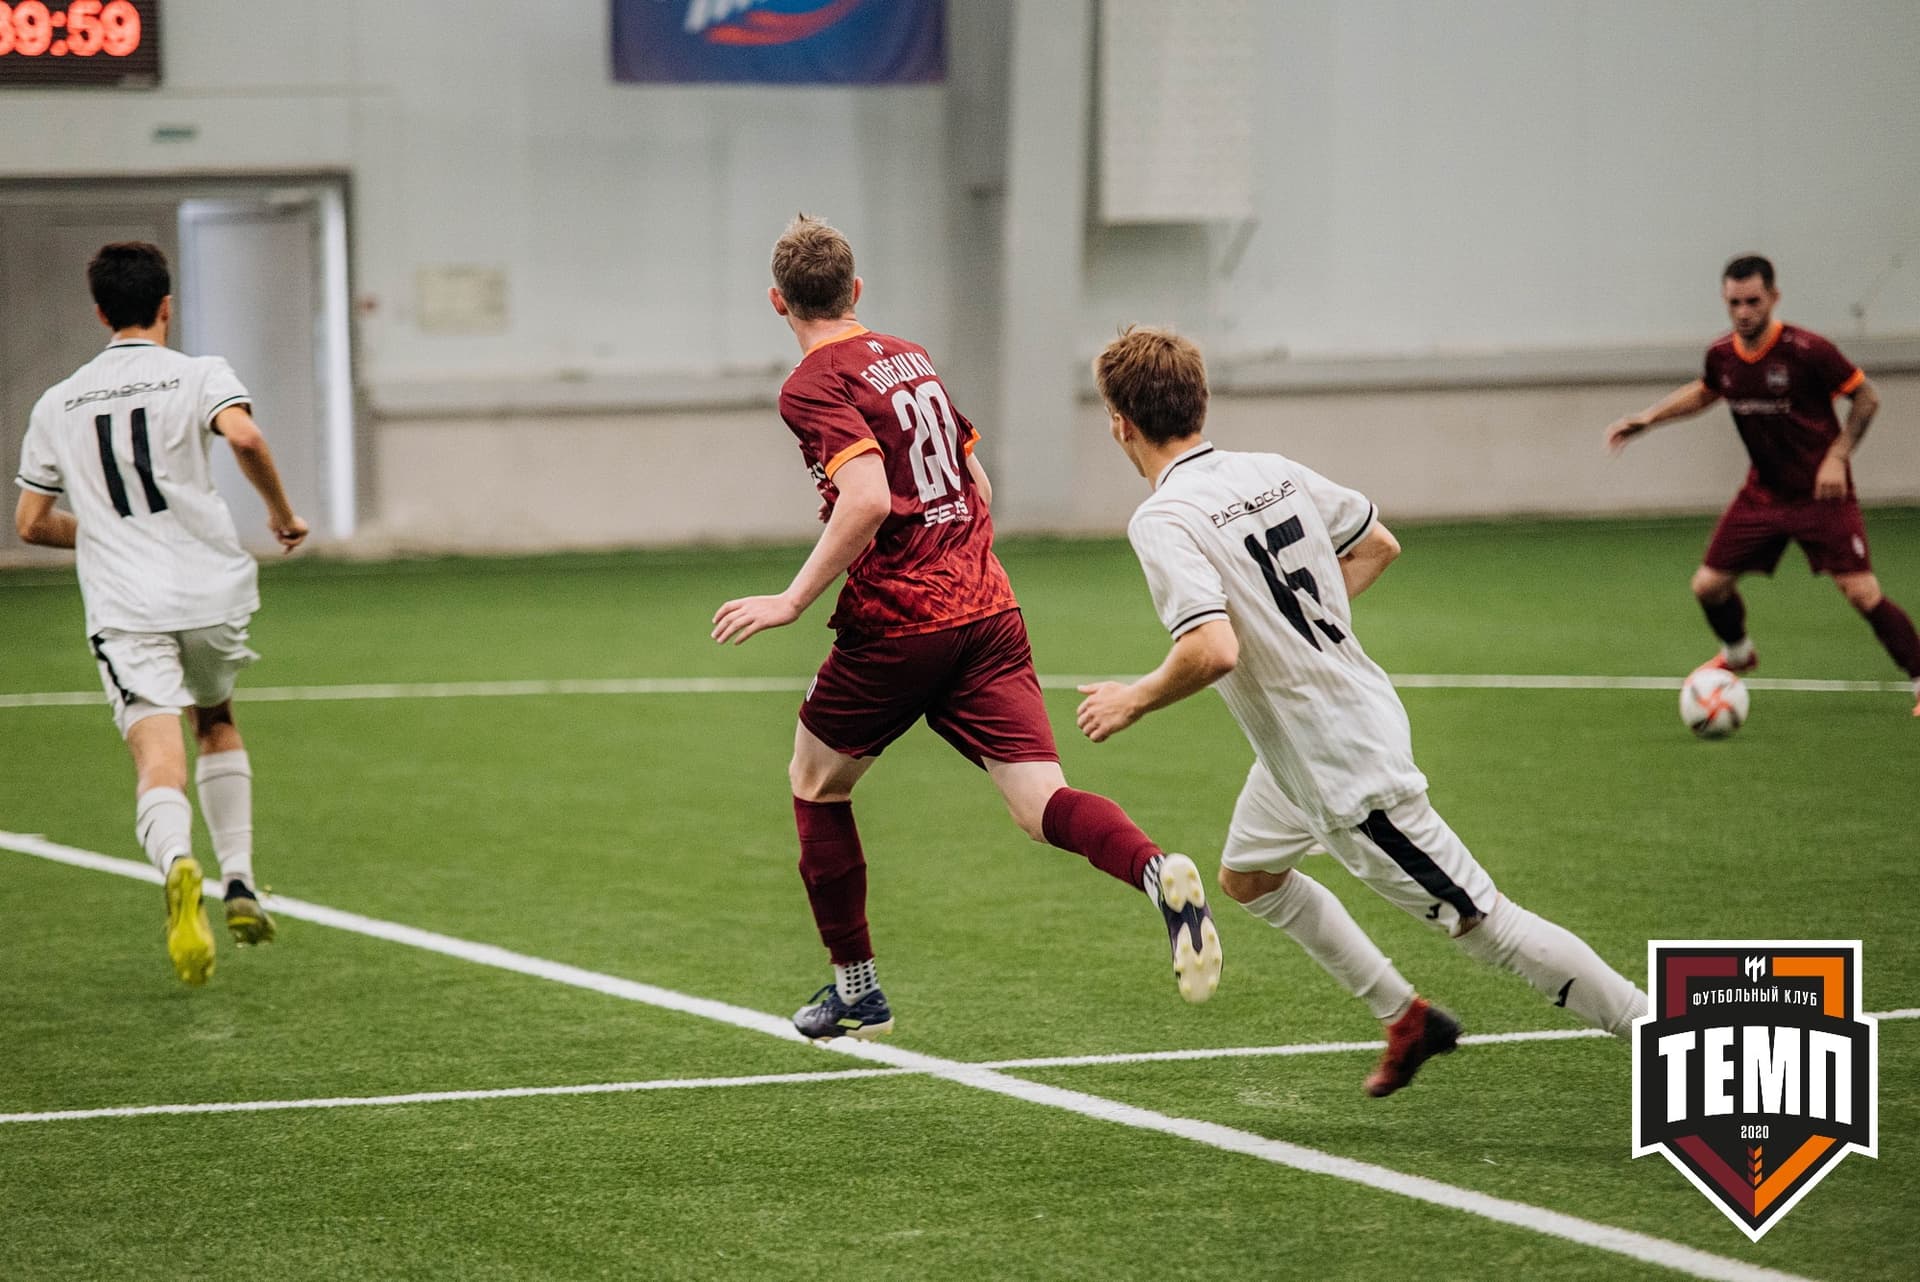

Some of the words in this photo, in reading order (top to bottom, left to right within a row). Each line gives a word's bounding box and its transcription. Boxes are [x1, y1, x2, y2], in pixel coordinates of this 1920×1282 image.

[95, 407, 168, 518] 11
[891, 380, 961, 504] 20
[1210, 480, 1297, 529] РАСАДСКАЯ
[1244, 514, 1346, 653] 15
